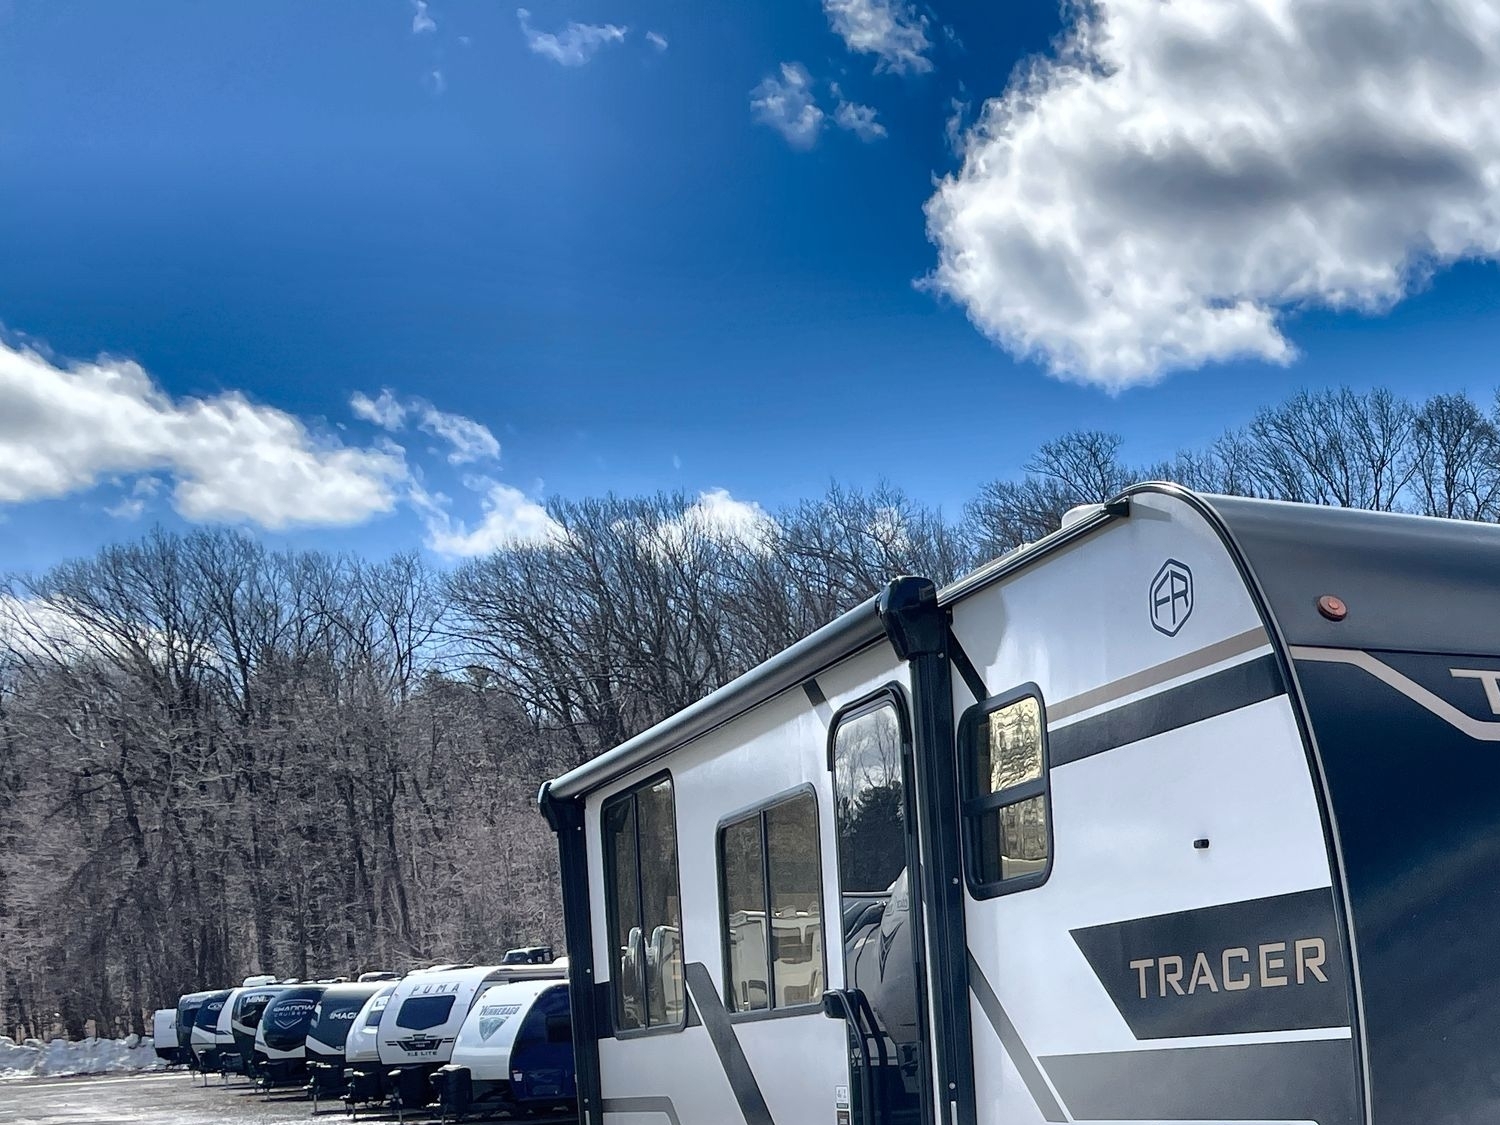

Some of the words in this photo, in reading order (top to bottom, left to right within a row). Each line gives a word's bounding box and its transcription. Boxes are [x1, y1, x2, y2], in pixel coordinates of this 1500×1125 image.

[1129, 936, 1329, 999] TRACER
[410, 983, 460, 996] PUMA
[272, 1003, 316, 1012] SHADOW
